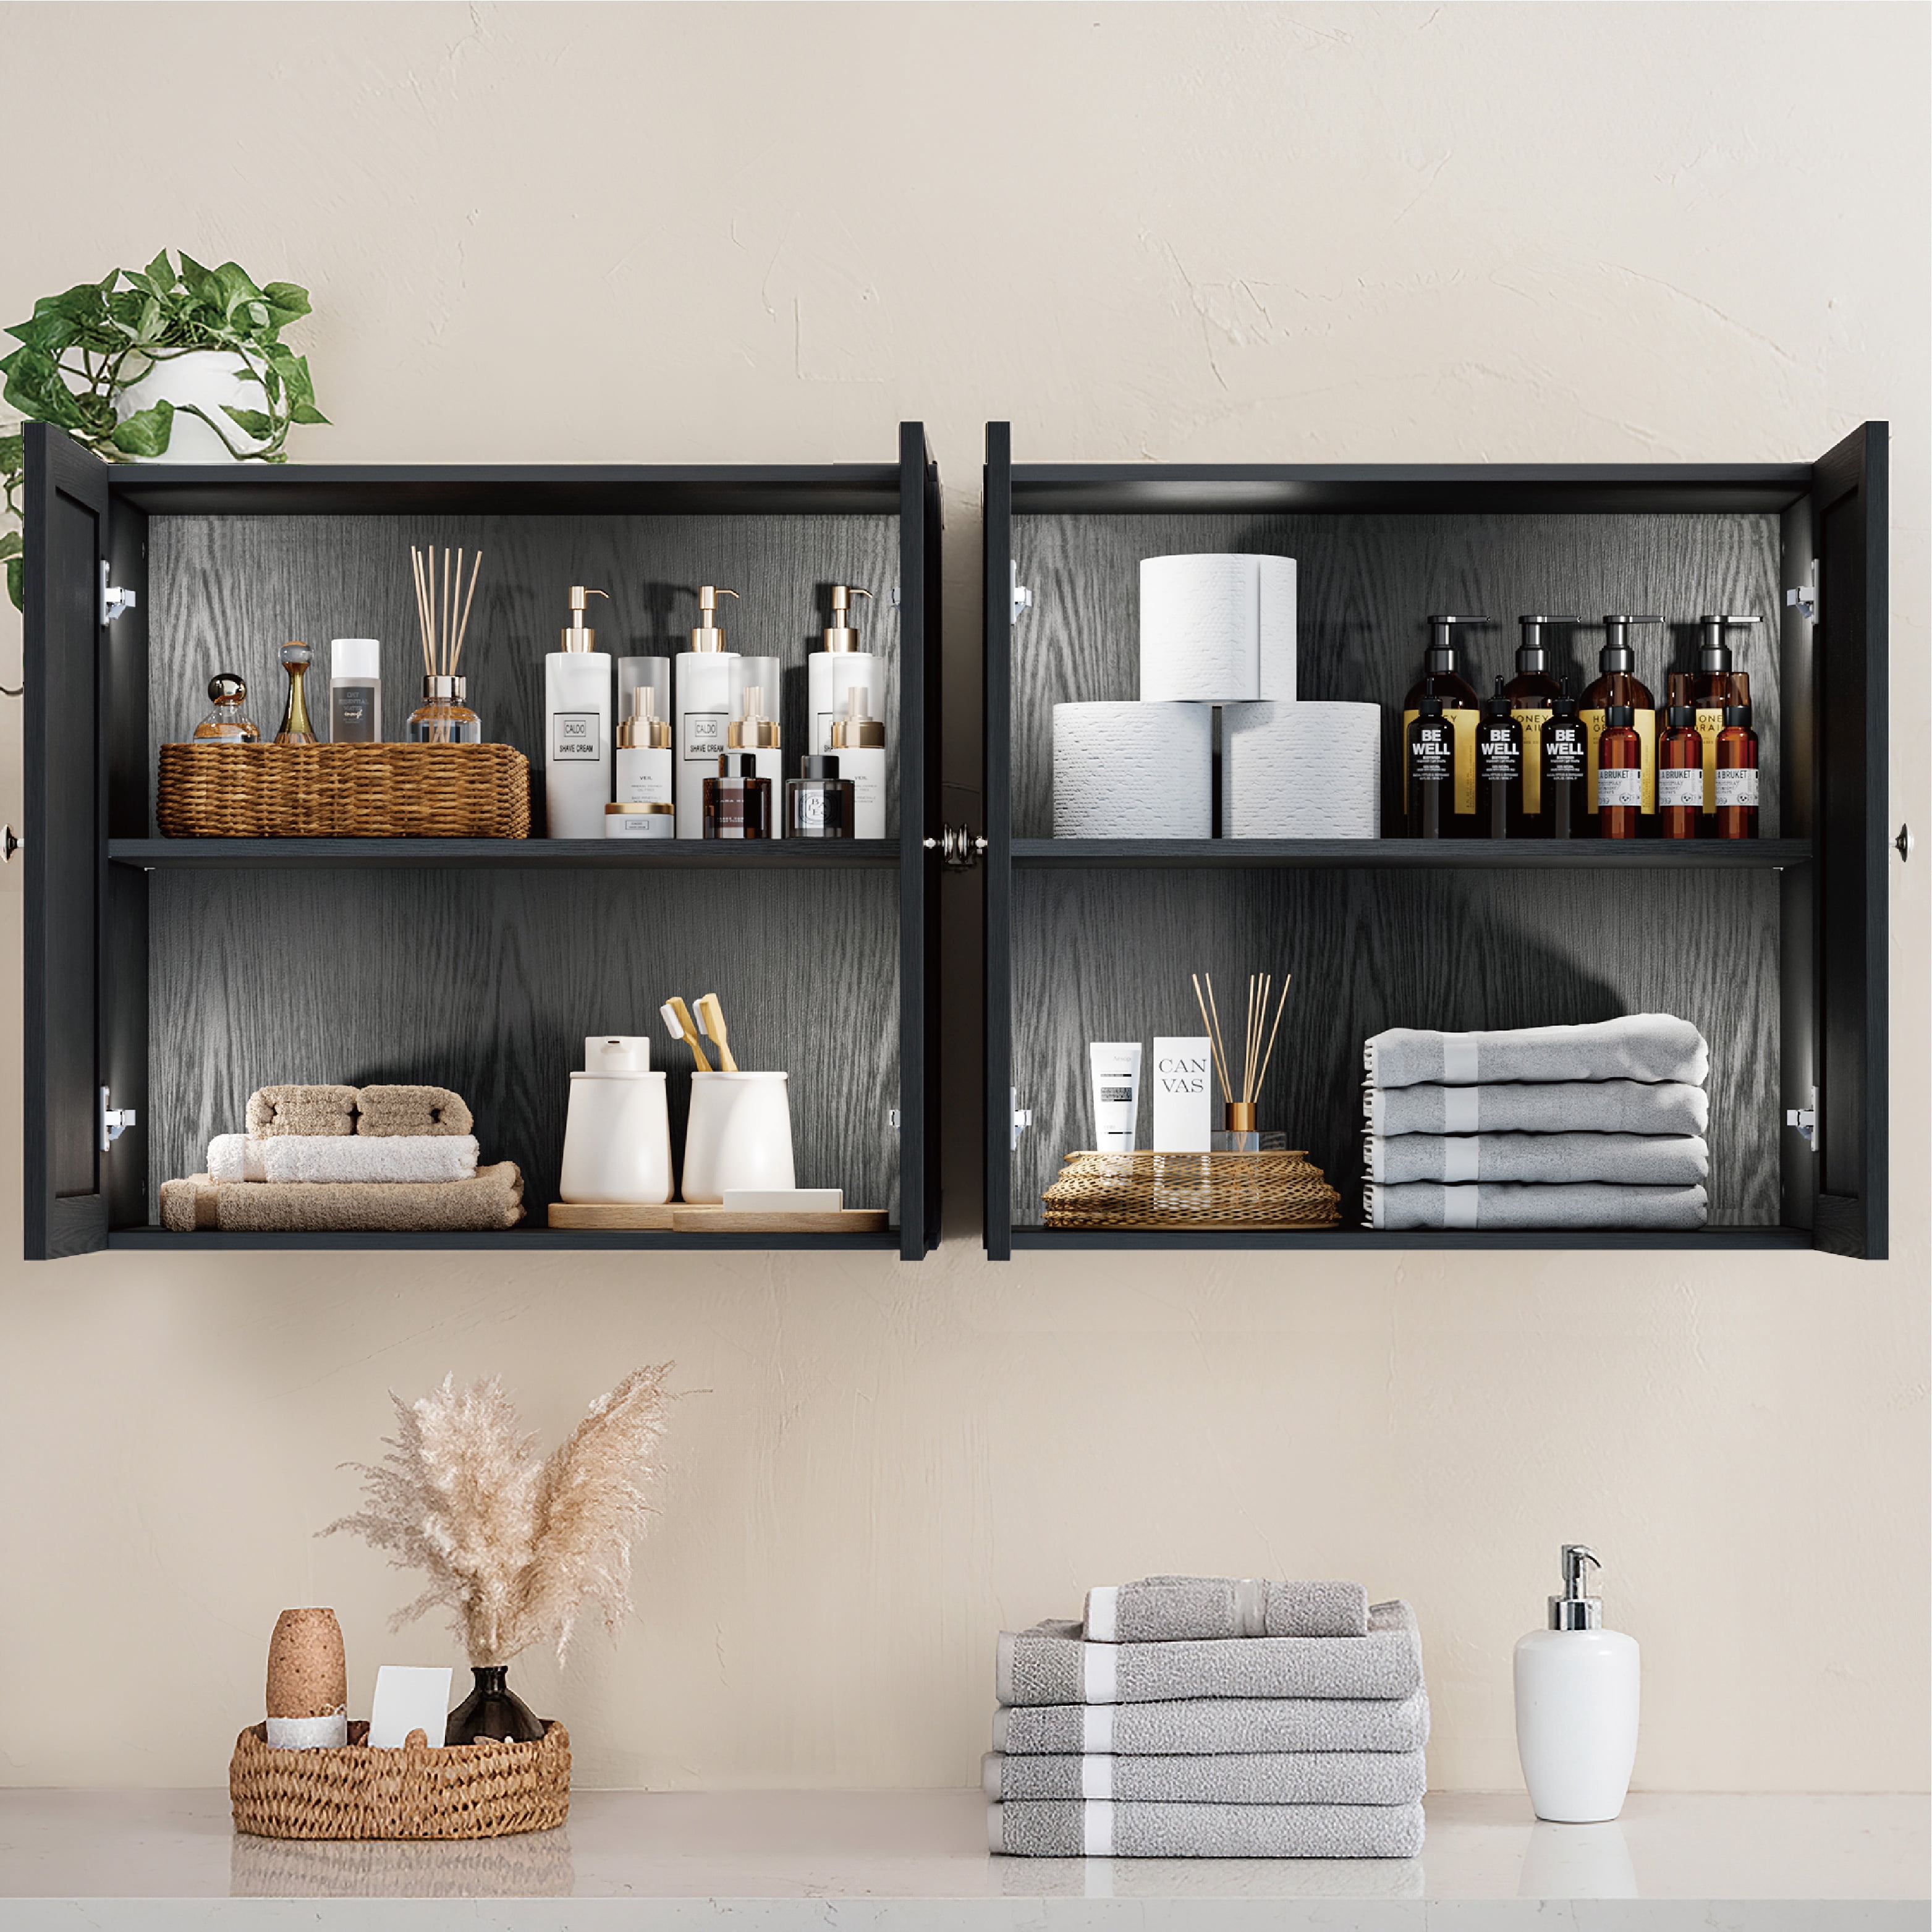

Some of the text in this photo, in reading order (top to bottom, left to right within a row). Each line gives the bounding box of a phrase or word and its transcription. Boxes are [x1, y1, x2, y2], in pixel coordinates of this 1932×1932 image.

[1512, 714, 1549, 722] ONEY
[1698, 714, 1722, 722] ONE
[565, 724, 585, 734] CALDO
[697, 724, 716, 734] CALDO
[1421, 729, 1442, 742] BE
[1490, 729, 1510, 742] BE
[1555, 729, 1575, 742] BE
[559, 745, 593, 753] SHAVE CREAM
[690, 745, 724, 753] SHAVE CREAM
[1412, 743, 1451, 755] WELL
[1481, 743, 1520, 755] WELL
[1546, 743, 1584, 755] WELL
[1158, 1058, 1207, 1074] CAN
[1161, 1078, 1205, 1093] VAS
